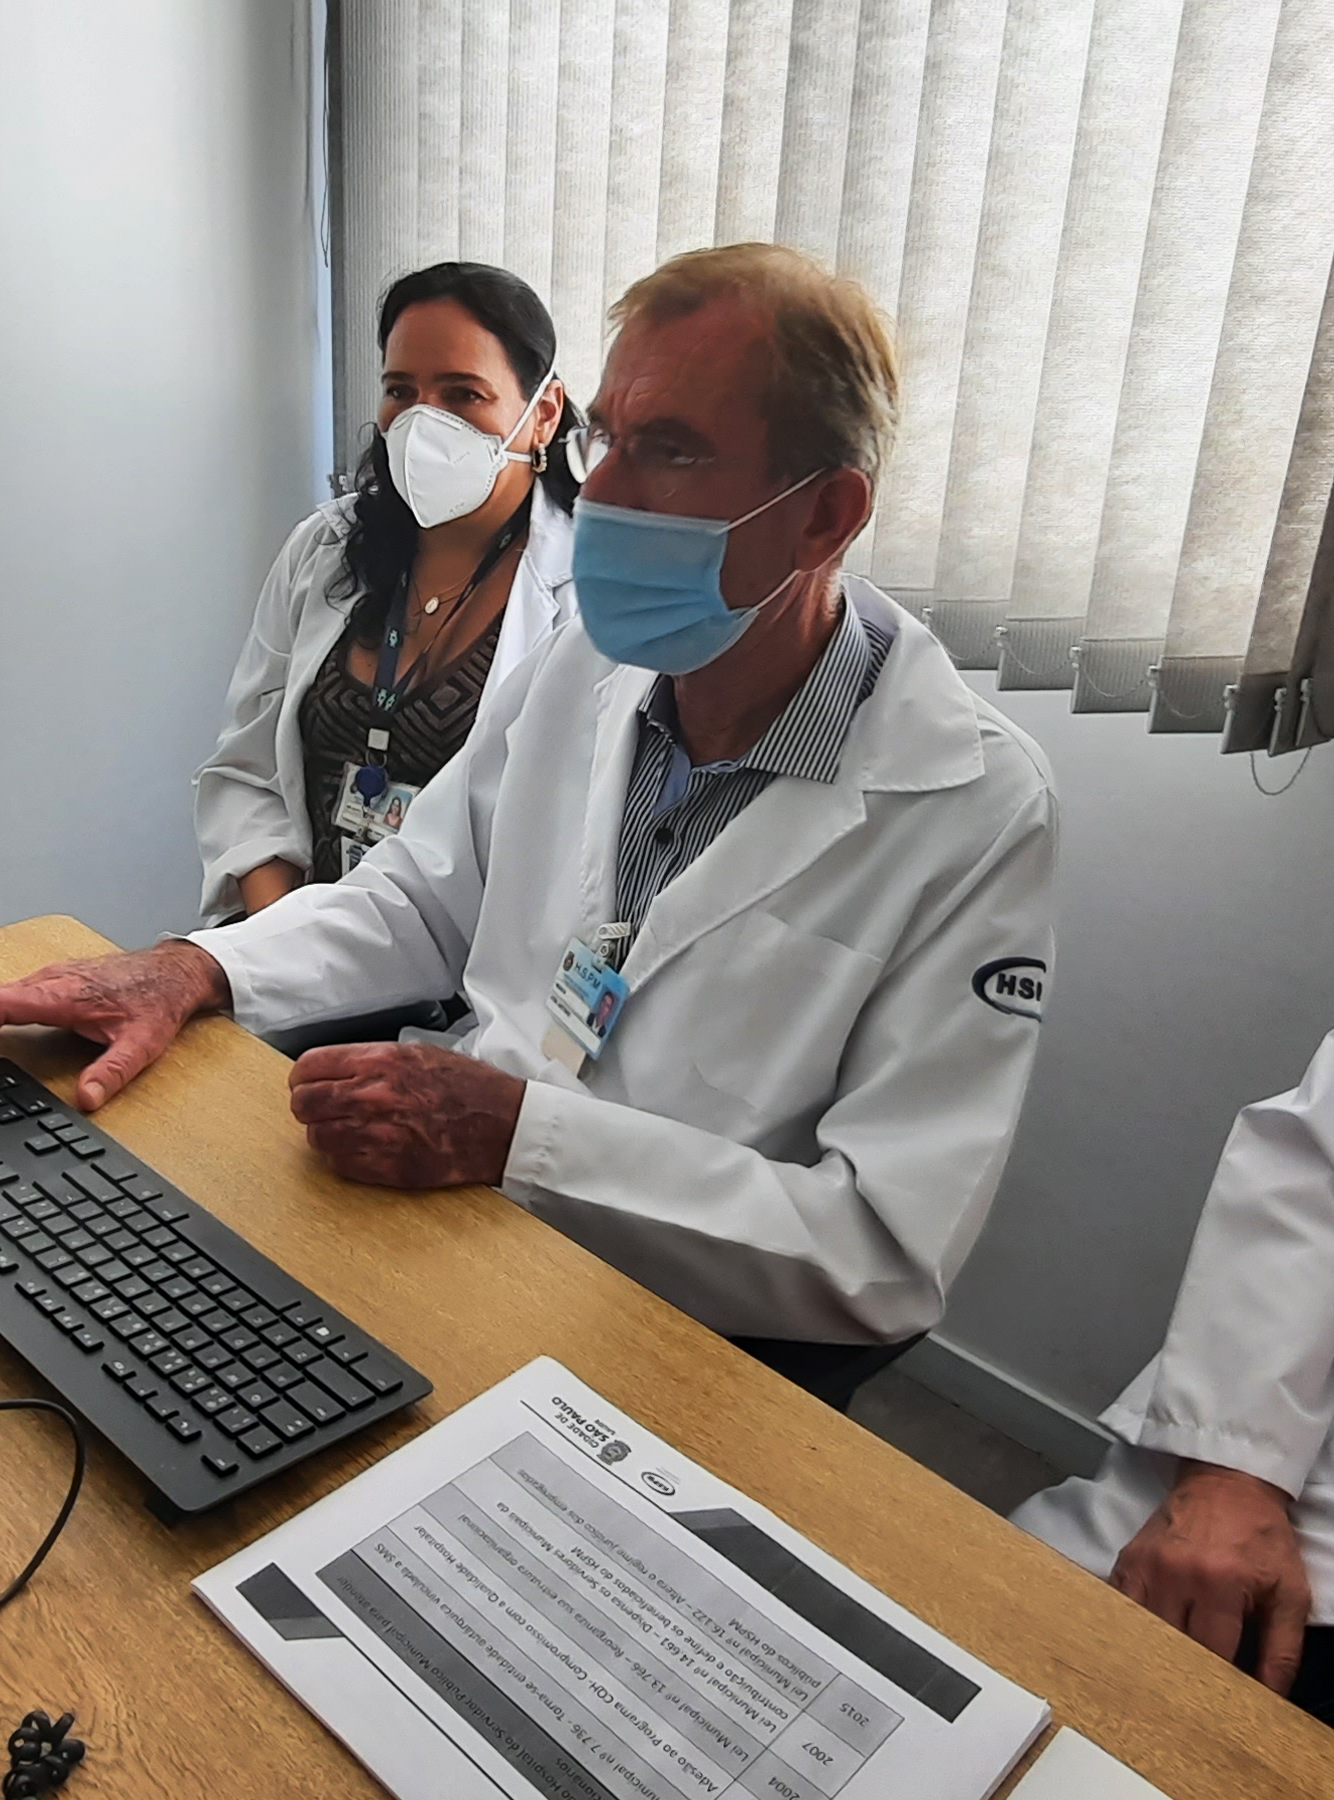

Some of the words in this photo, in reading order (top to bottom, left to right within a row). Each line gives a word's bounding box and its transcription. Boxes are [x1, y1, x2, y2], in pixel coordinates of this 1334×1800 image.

[551, 1396, 587, 1425] PAULO
[554, 1412, 568, 1423] DE
[566, 1422, 599, 1448] CIDADE
[584, 1423, 609, 1444] SÃO
[496, 1501, 509, 1512] da
[566, 1510, 584, 1524] dos
[413, 1525, 456, 1564] Hospitalar
[508, 1511, 554, 1551] Municipais
[373, 1542, 396, 1562] SMS
[394, 1560, 402, 1568] a
[570, 1546, 600, 1570] HSPM
[615, 1549, 648, 1574] regime
[455, 1562, 499, 1603] Qualidade
[516, 1564, 557, 1599] estrutura
[552, 1549, 600, 1589] Servidores
[599, 1567, 613, 1579] do
[647, 1572, 656, 1580] o
[400, 1566, 440, 1604] vinculada
[598, 1585, 611, 1597] os
[656, 1579, 686, 1604] Altera
[504, 1606, 526, 1625] com
[556, 1598, 575, 1614] sua
[610, 1595, 653, 1633] Dispensa
[612, 1578, 671, 1628] beneficiados
[368, 1607, 391, 1627] para
[670, 1624, 684, 1636] os
[573, 1612, 624, 1658] Reorganiza
[727, 1618, 760, 1645] HSPM
[383, 1625, 431, 1669] Municipal
[525, 1624, 587, 1680] Compromisso
[659, 1637, 694, 1667] 14.661
[683, 1635, 716, 1662] define
[760, 1642, 776, 1656] do
[485, 1644, 526, 1682] entidade
[715, 1661, 724, 1670] e
[738, 1646, 791, 1689] Municipal
[776, 1654, 821, 1688] públicos
[630, 1662, 666, 1693] 13.766
[706, 1676, 759, 1720] Municipal
[724, 1668, 788, 1719] contribuição
[789, 1686, 808, 1701] Lei
[463, 1698, 506, 1741] Servidor
[613, 1701, 662, 1746] Programa
[677, 1702, 731, 1748] Municipal
[757, 1716, 776, 1733] Lei
[839, 1702, 869, 1727] 2015
[504, 1735, 520, 1750] do
[569, 1724, 601, 1753] 7.736
[662, 1743, 677, 1758] ao
[729, 1744, 748, 1762] Lei
[801, 1742, 833, 1766] 2007
[515, 1747, 562, 1793] Hospital
[554, 1757, 603, 1800] cionários
[677, 1756, 718, 1792] Adesão
[767, 1776, 800, 1800] 2004
